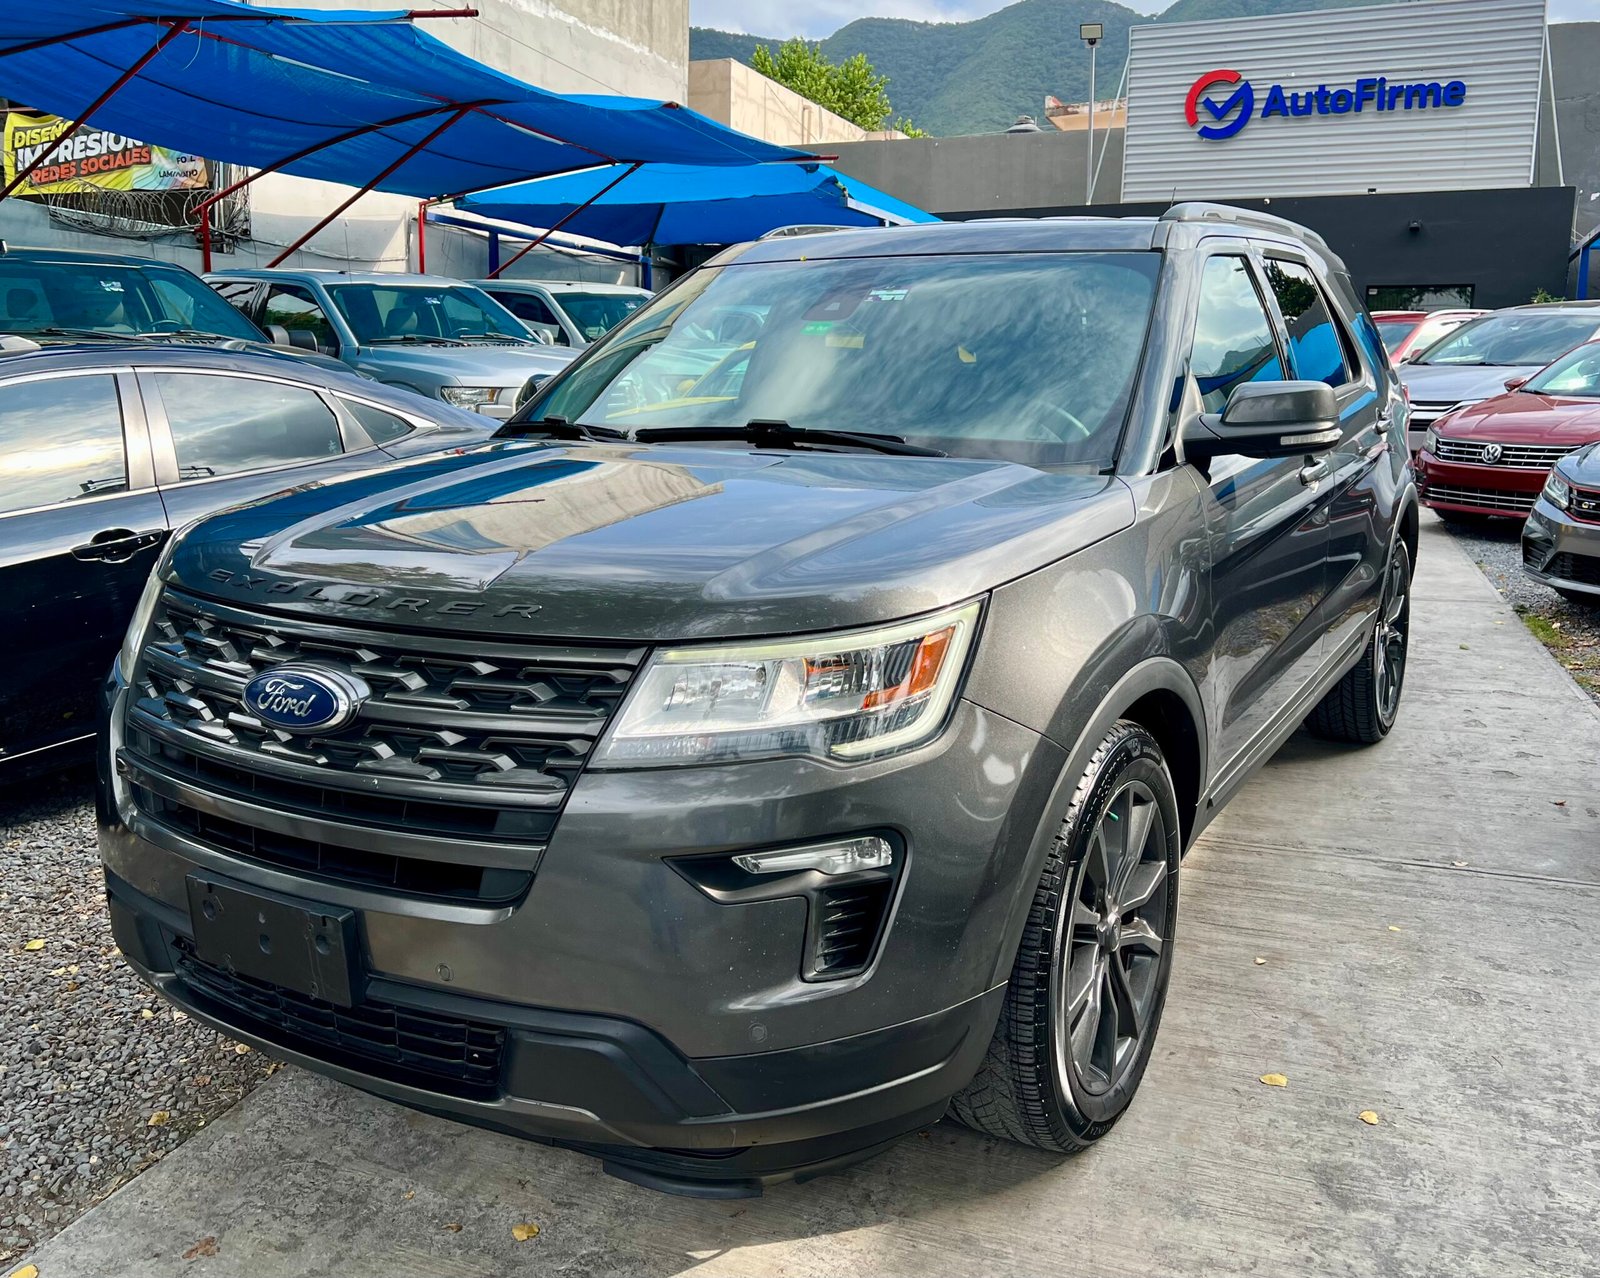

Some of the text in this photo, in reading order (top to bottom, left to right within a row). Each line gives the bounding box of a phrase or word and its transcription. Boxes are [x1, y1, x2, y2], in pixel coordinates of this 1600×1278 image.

[1261, 77, 1466, 118] AutoFirme
[31, 147, 150, 183] REDES SOCIALES
[207, 568, 543, 618] EXPLORER
[257, 678, 317, 718] Ford
